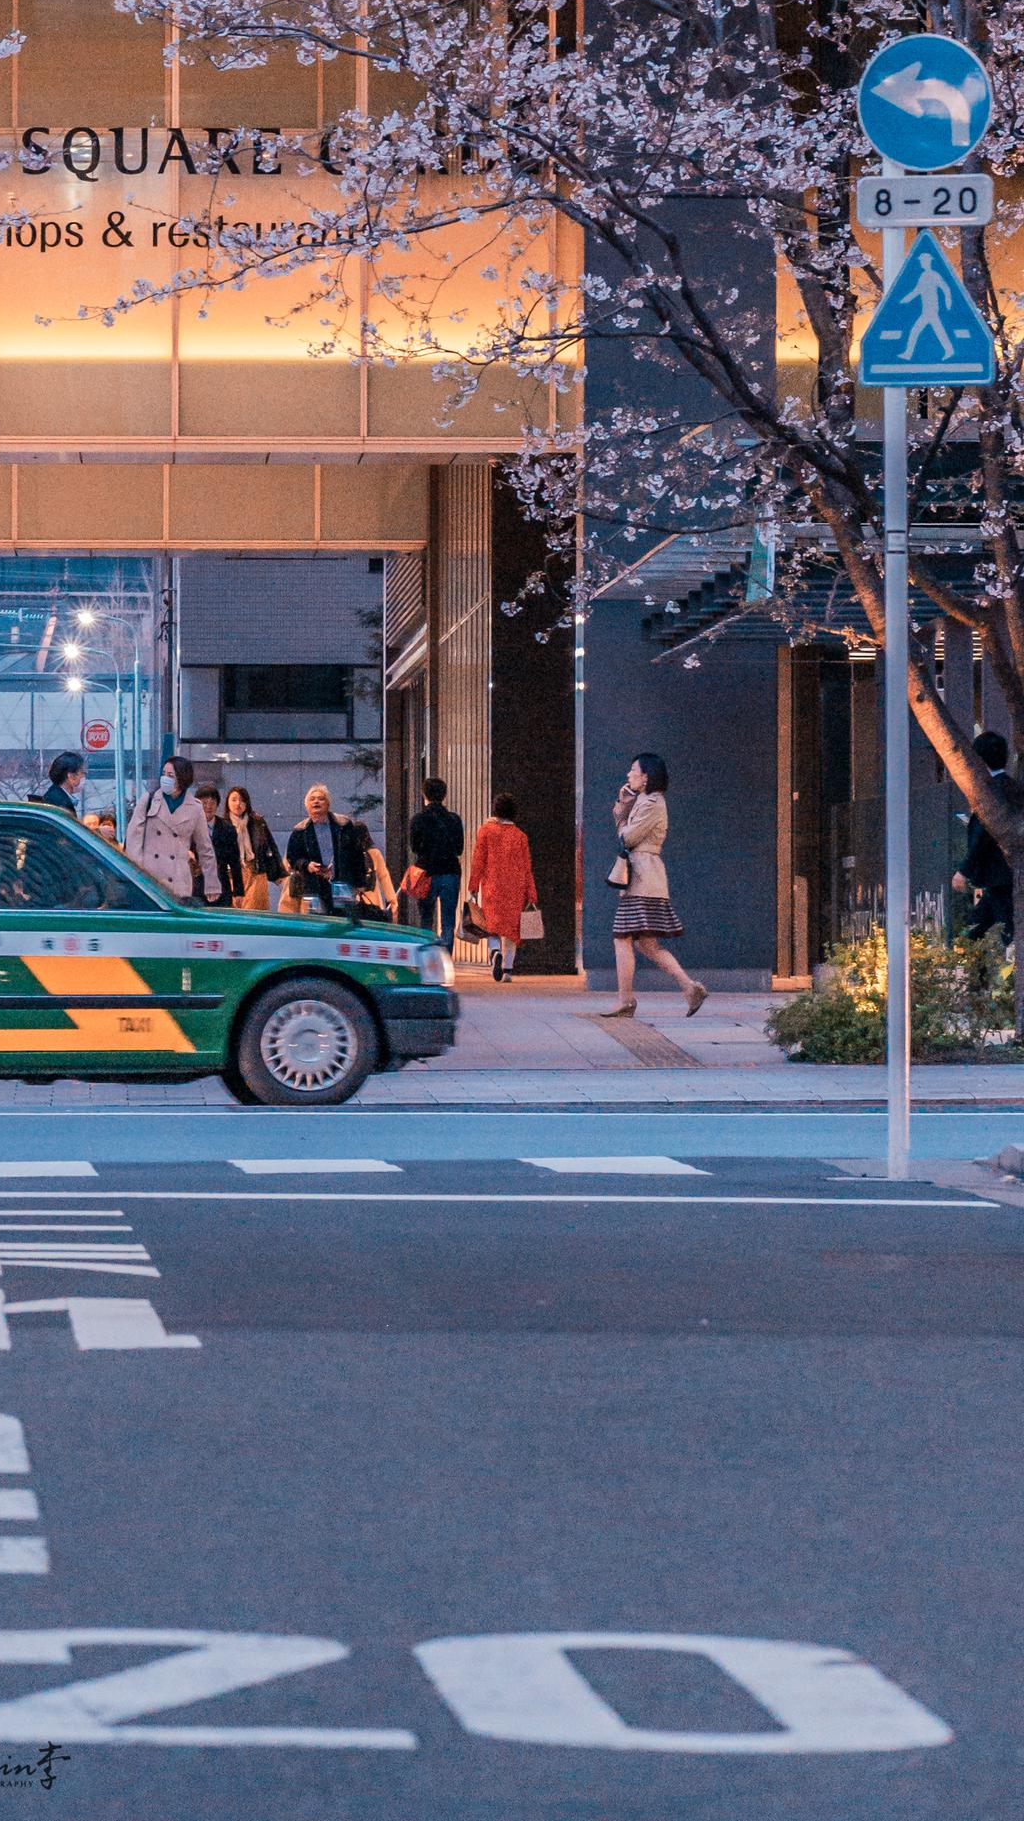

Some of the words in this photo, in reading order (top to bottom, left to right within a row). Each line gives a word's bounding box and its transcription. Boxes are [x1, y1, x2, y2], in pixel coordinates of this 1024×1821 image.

[21, 126, 281, 183] SQUARE
[102, 211, 134, 248] &
[151, 214, 381, 248] restua
